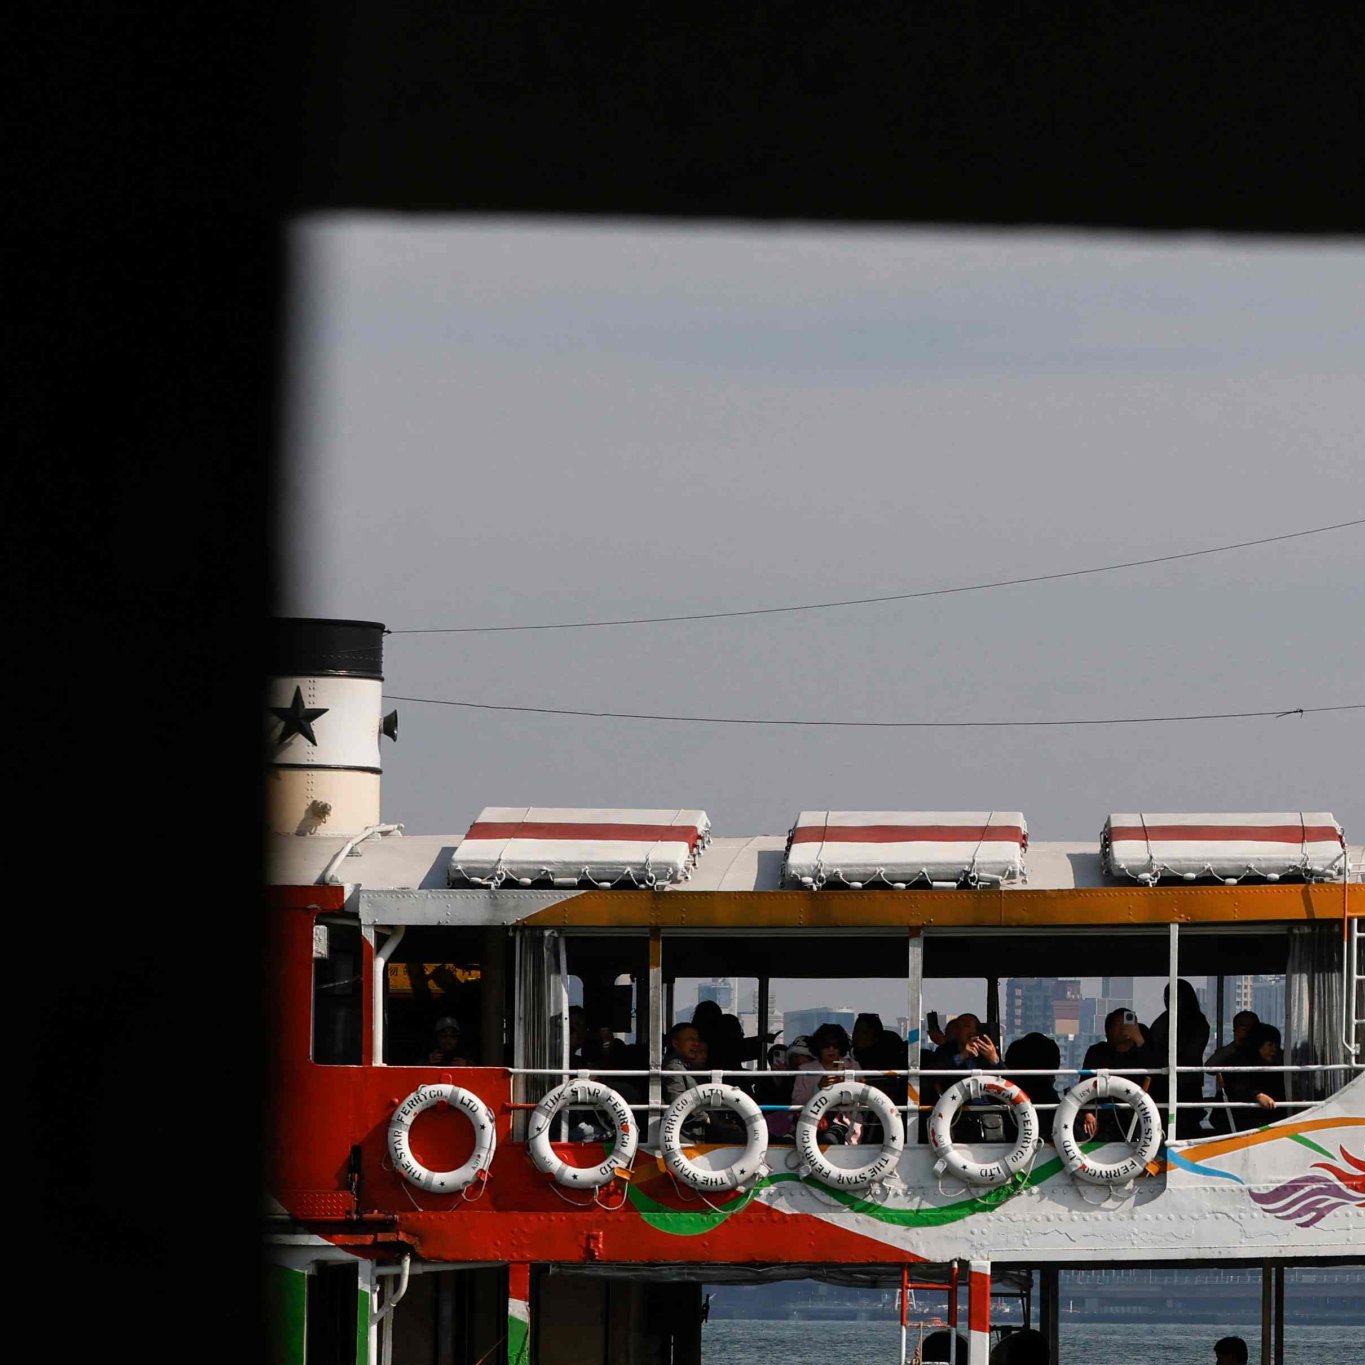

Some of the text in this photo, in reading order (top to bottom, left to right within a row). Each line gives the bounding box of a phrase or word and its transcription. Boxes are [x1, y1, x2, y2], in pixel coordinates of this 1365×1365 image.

[460, 1096, 479, 1113] LTD
[810, 1096, 828, 1115] LTD
[1137, 1100, 1152, 1124] THE
[393, 1130, 406, 1160] STAR
[1062, 1140, 1077, 1161] LTD
[1138, 1128, 1153, 1158] STAR
[402, 1160, 422, 1181] THE
[599, 1158, 619, 1176] LTD
[673, 1159, 698, 1182] STAR
[868, 1157, 889, 1178] THE
[980, 1166, 1001, 1178] LTD
[701, 1176, 726, 1186] THE
[837, 1173, 867, 1185] STAR
